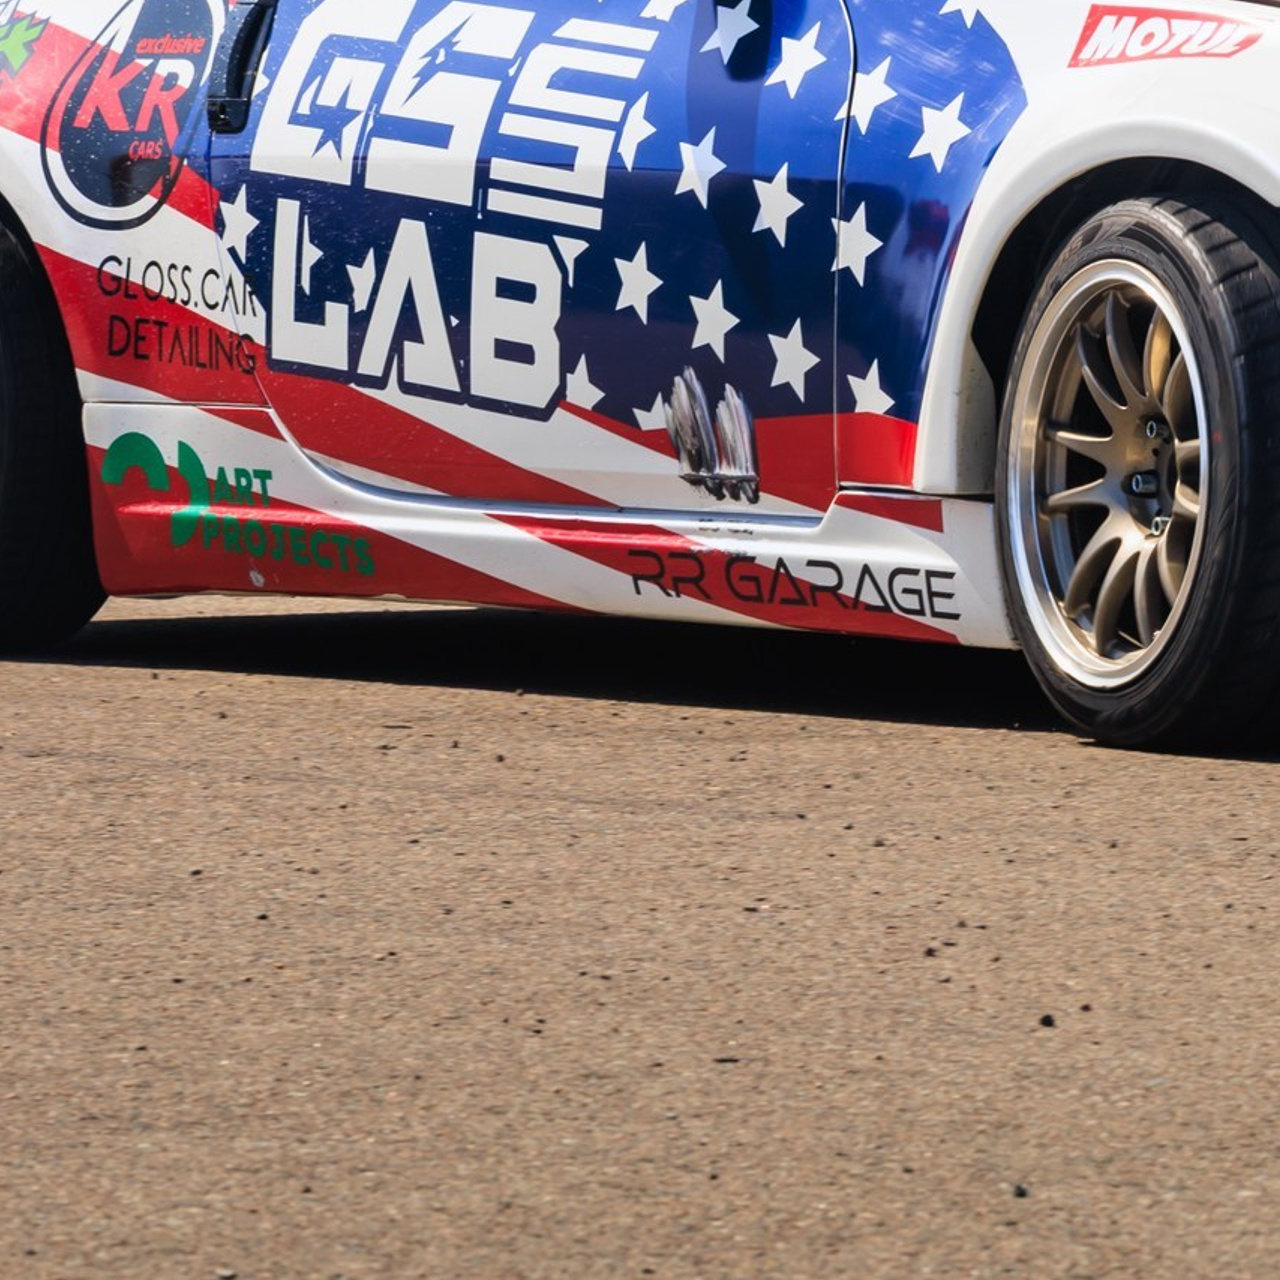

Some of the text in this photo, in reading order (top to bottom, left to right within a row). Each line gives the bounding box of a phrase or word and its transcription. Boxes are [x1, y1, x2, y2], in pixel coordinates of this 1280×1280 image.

[135, 32, 206, 54] exclusive
[1077, 14, 1256, 59] MOTUL
[73, 17, 196, 149] KR
[128, 140, 164, 161] CARS
[272, 199, 562, 409] LAB
[107, 314, 256, 375] DETAILING
[214, 466, 273, 507] ART
[203, 513, 376, 576] PROJECTS
[628, 549, 962, 621] RR GARAGE
